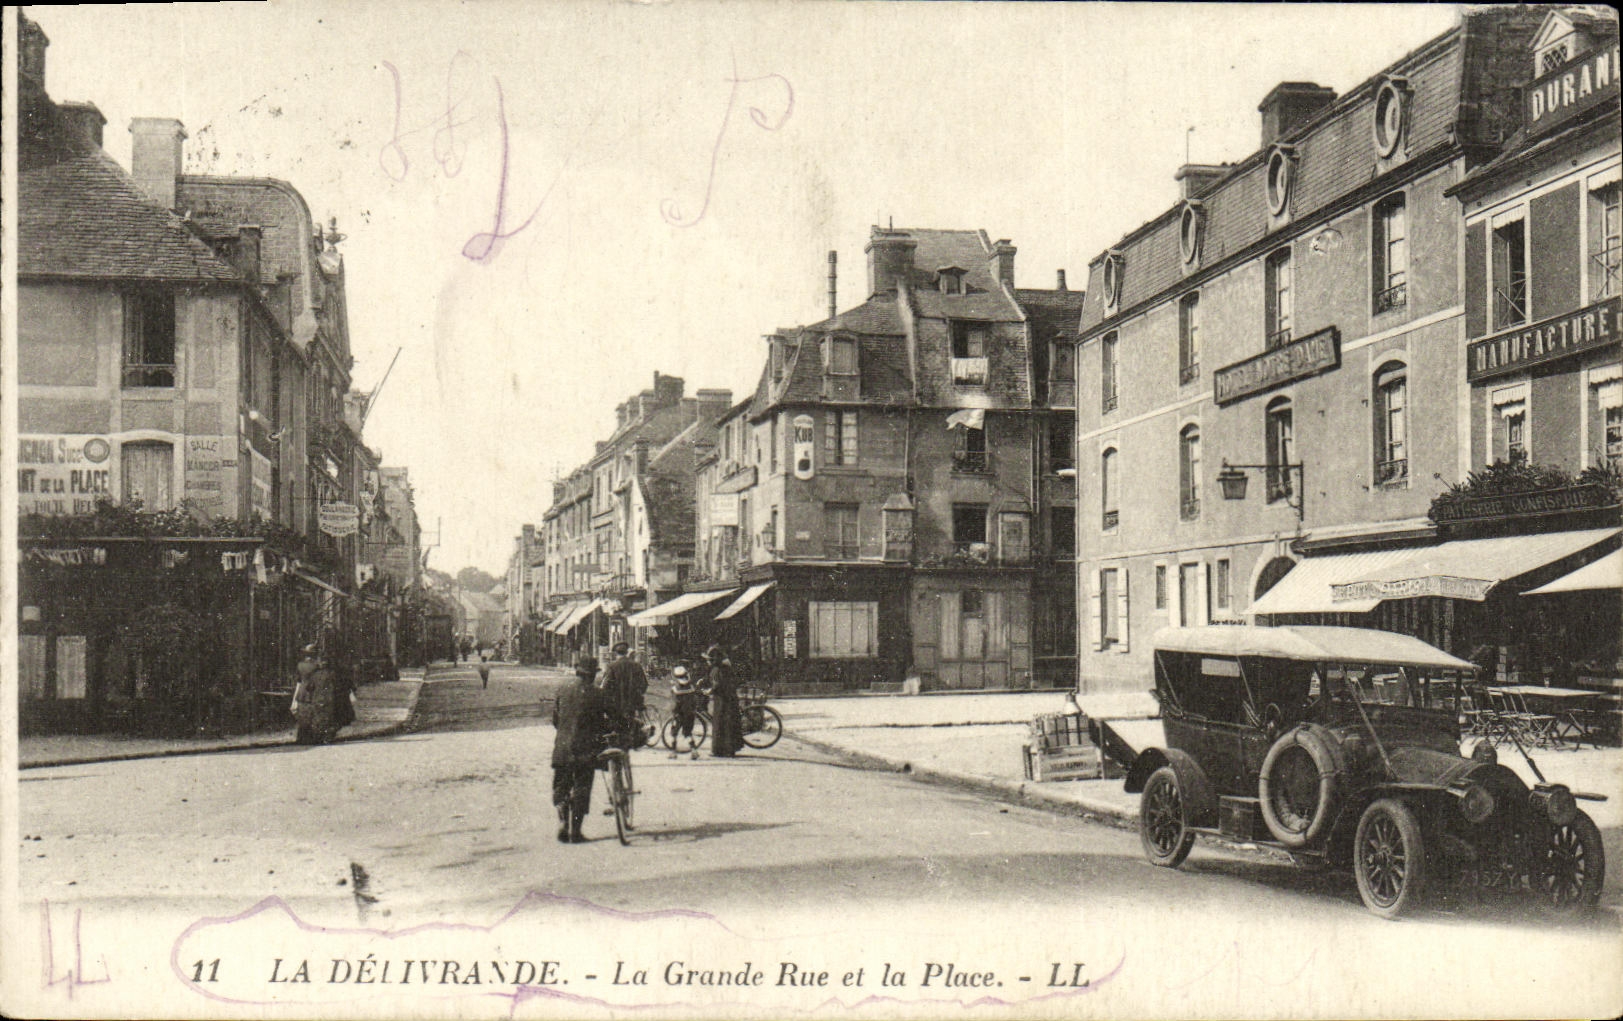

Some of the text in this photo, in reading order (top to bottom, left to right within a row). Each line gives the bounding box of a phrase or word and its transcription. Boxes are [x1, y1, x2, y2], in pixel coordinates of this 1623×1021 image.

[1476, 308, 1609, 371] MANUFACTURE
[794, 426, 813, 443] KUB
[190, 440, 218, 452] SALLE
[70, 469, 108, 494] PLACE
